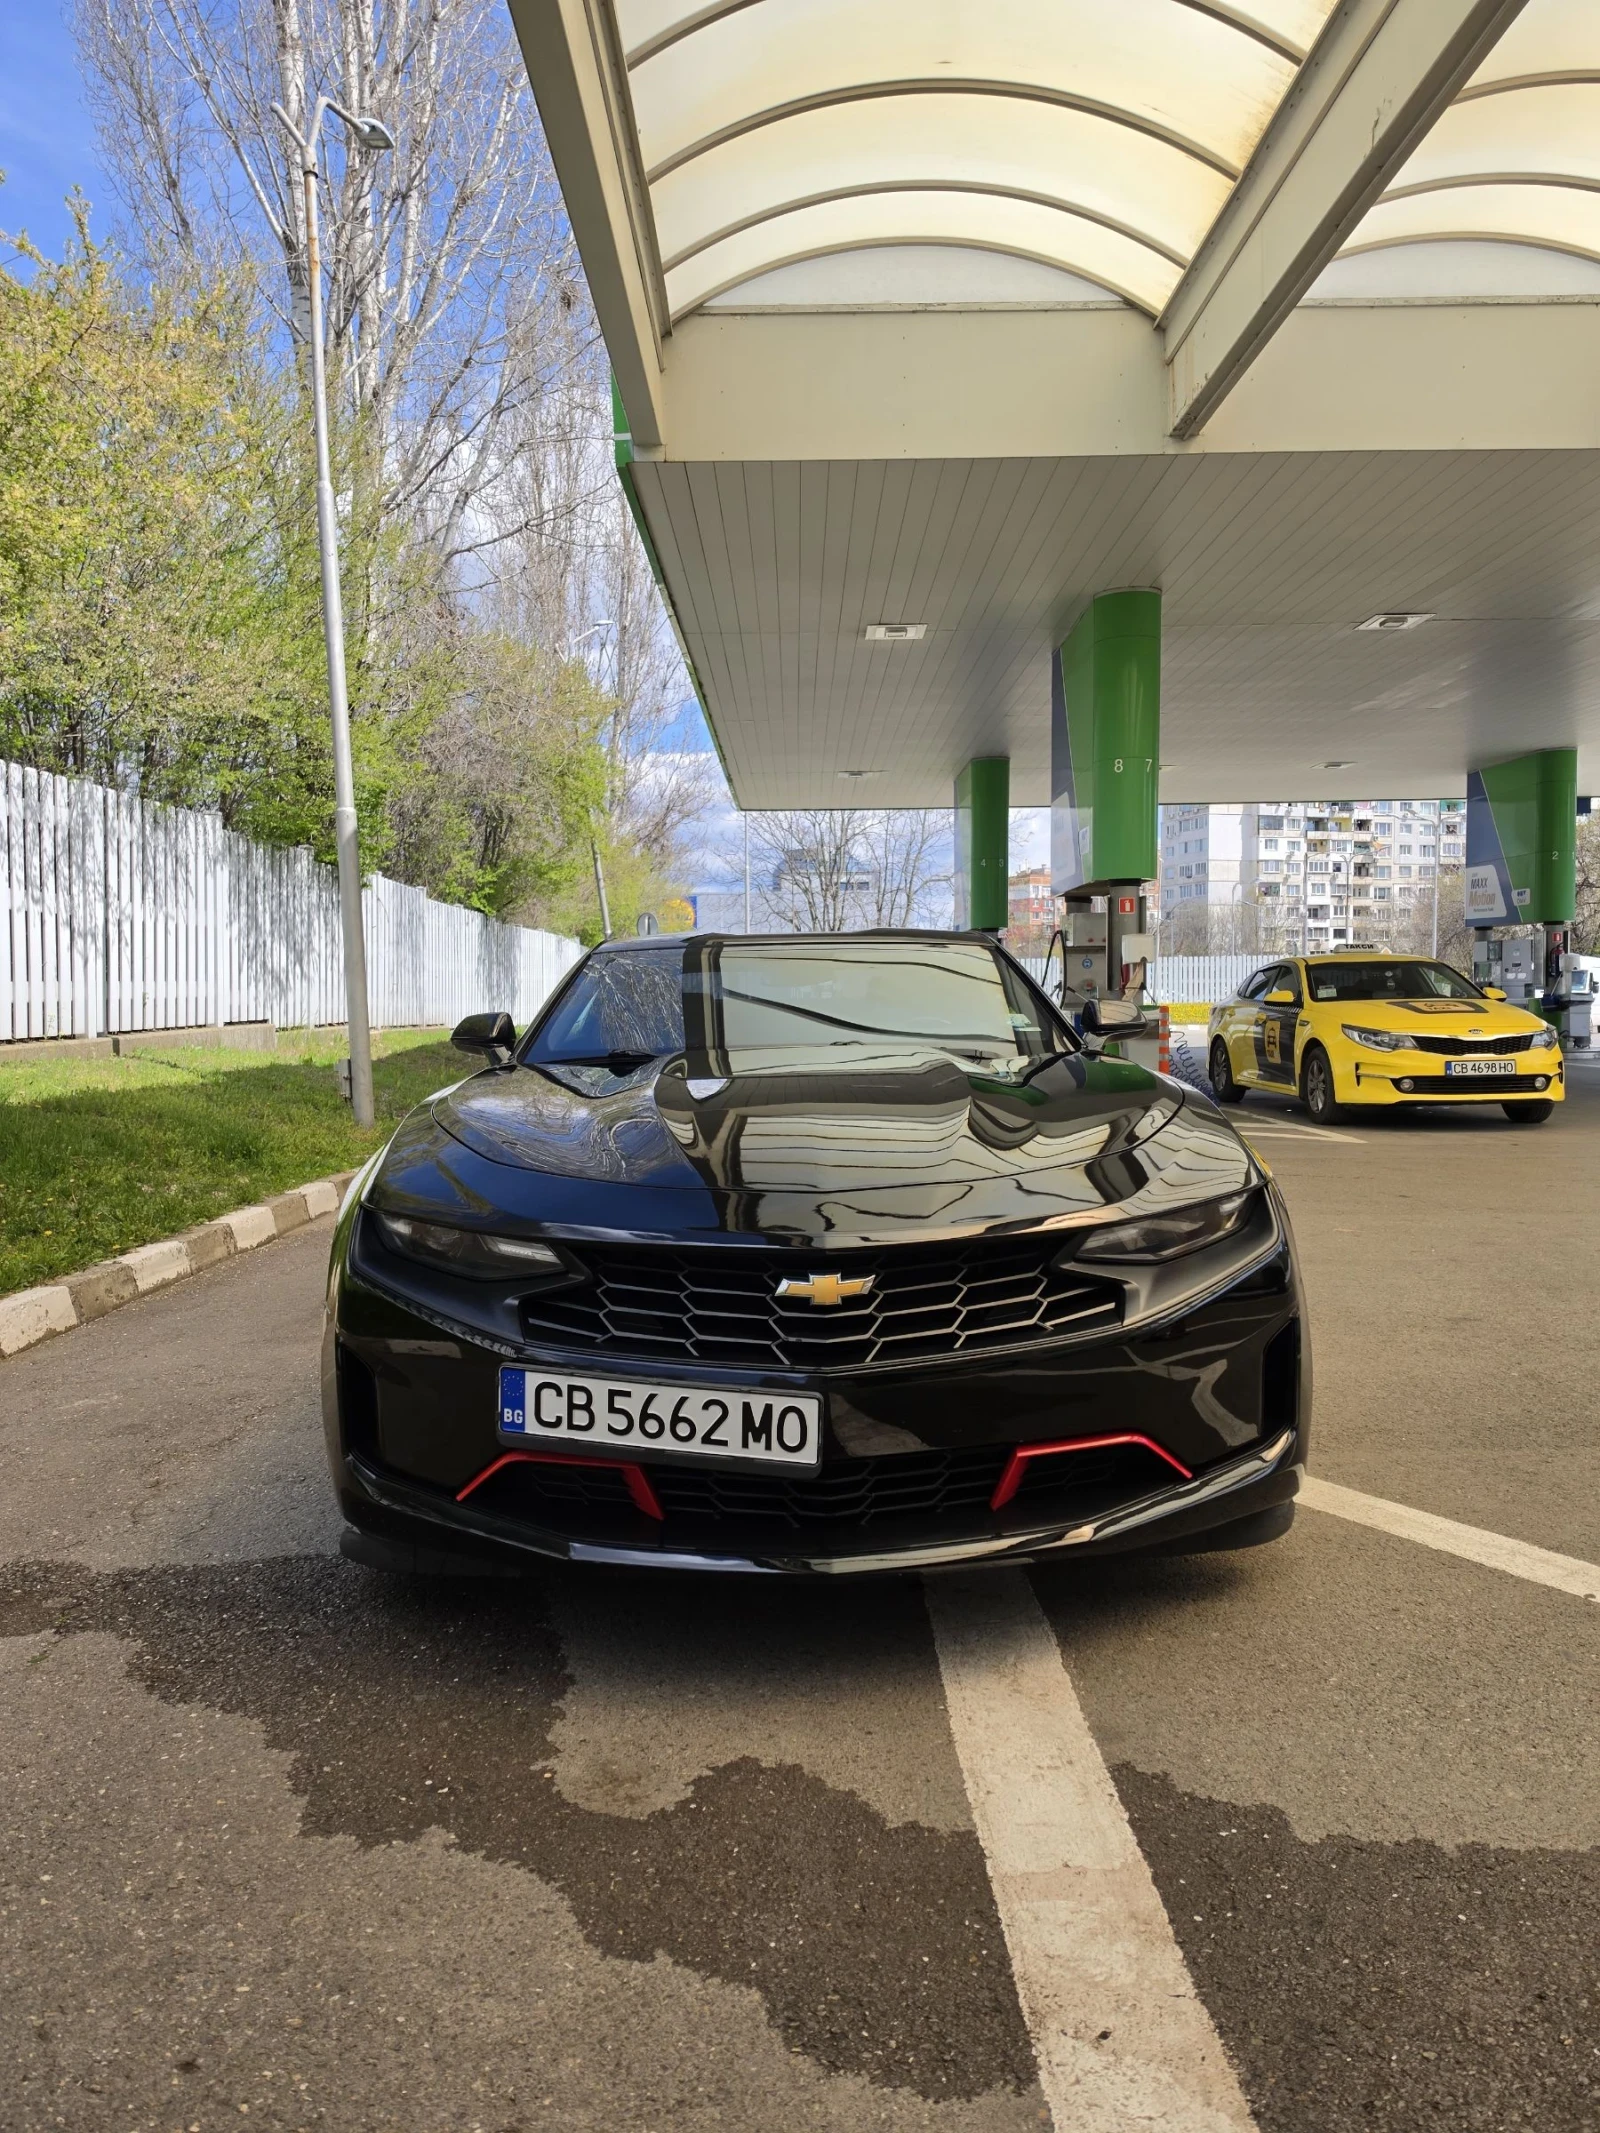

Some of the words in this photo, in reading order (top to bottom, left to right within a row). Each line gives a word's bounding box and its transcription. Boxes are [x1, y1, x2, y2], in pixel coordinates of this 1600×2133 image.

[1114, 758, 1123, 773] 8
[1146, 758, 1153, 773] 7
[1552, 851, 1559, 860] 2
[980, 859, 986, 867] 4
[998, 859, 1004, 867] 3
[1470, 877, 1488, 890] MAXX
[1469, 890, 1496, 907] Motion
[1454, 1063, 1468, 1074] CB
[1470, 1062, 1497, 1073] 4698
[1499, 1062, 1514, 1072] HO
[503, 1409, 524, 1424] BG
[534, 1381, 596, 1432] CB
[607, 1388, 729, 1447] 5662
[741, 1400, 808, 1453] MO
